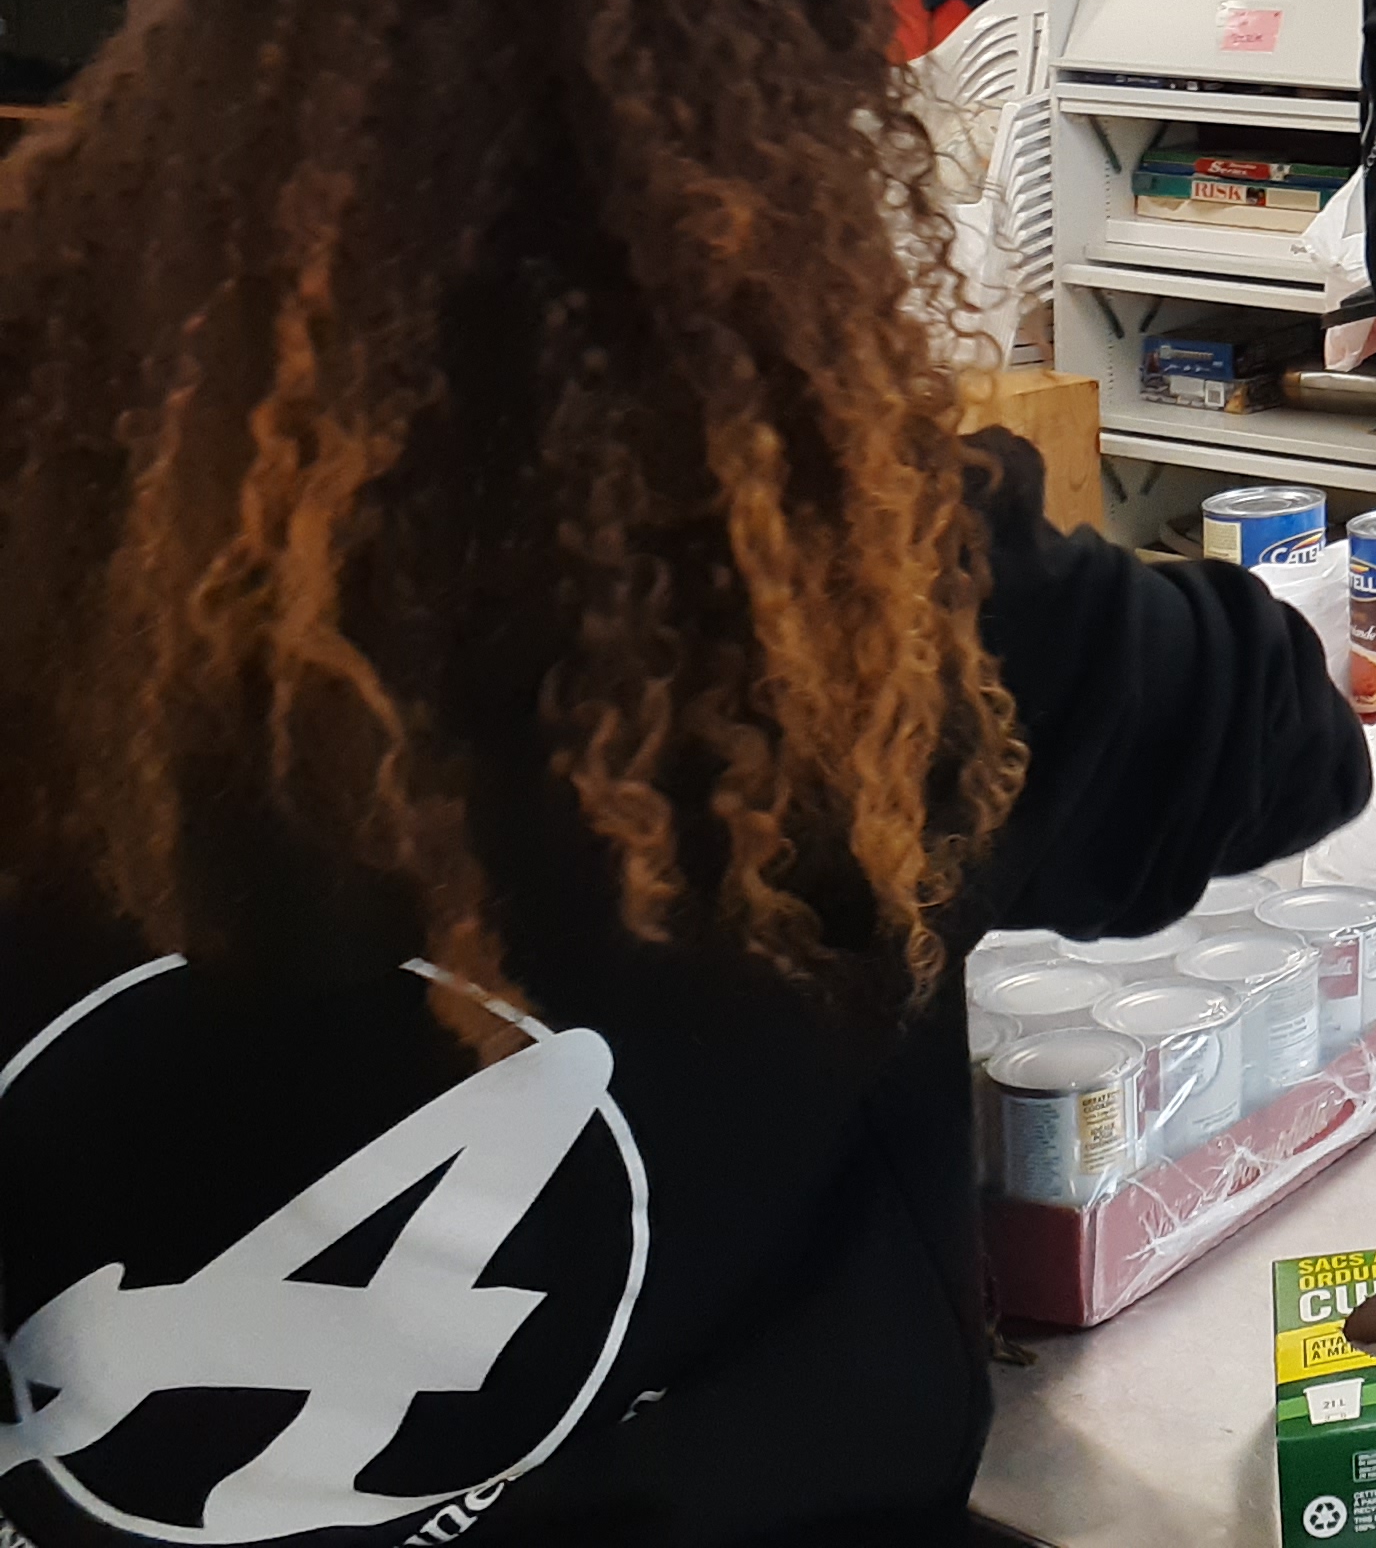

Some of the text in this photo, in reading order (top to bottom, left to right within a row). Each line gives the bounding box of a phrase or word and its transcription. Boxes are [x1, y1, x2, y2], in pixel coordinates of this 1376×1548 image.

[1194, 182, 1243, 202] RISK
[1299, 1251, 1365, 1275] SACS
[1323, 1400, 1336, 1410] 21
